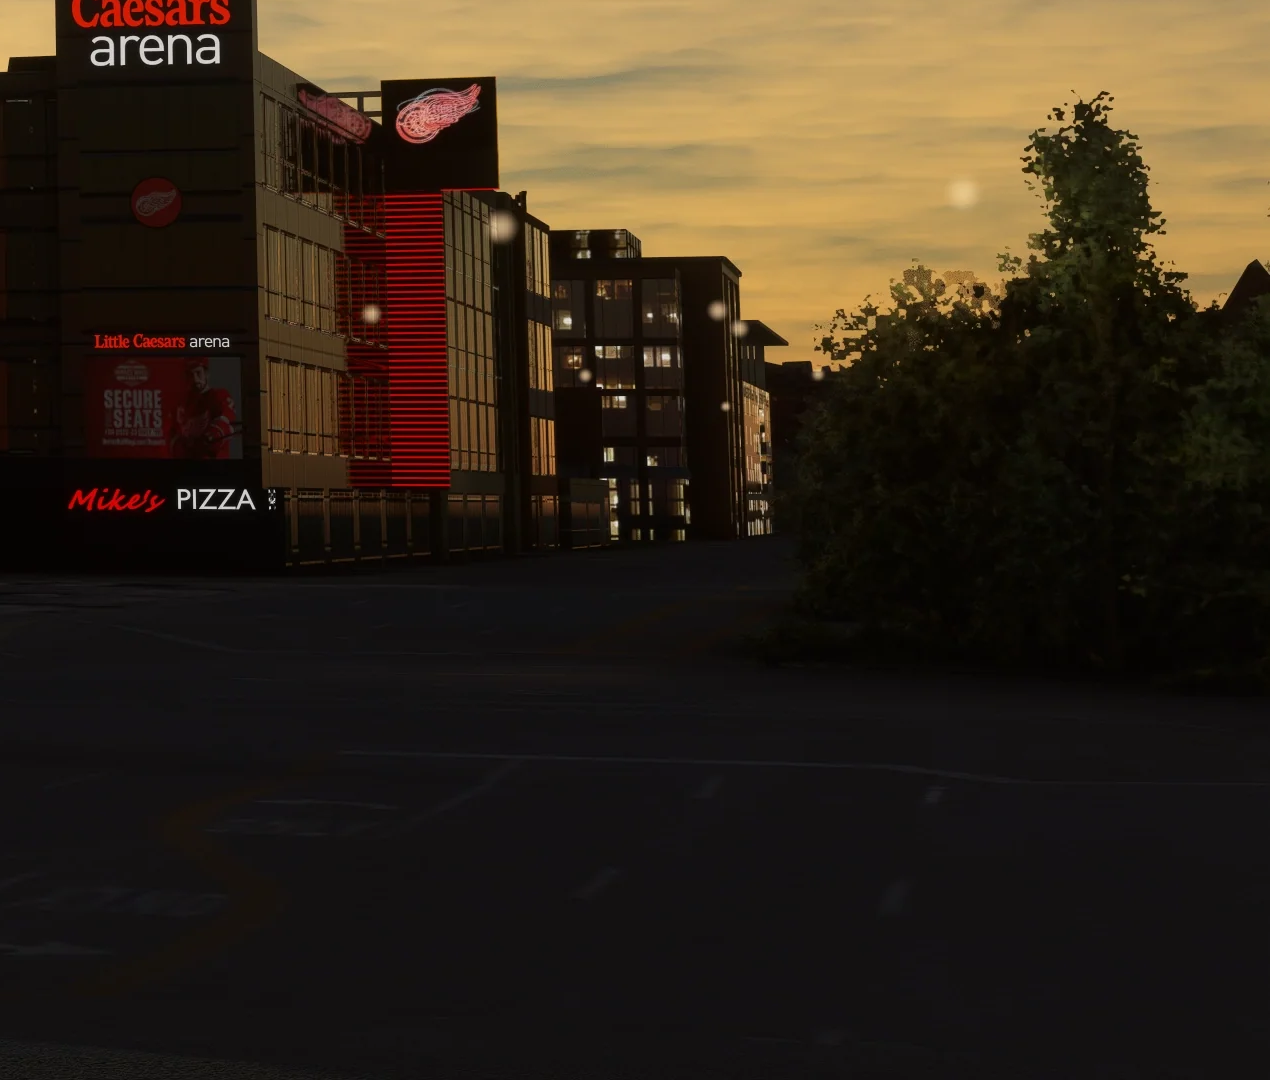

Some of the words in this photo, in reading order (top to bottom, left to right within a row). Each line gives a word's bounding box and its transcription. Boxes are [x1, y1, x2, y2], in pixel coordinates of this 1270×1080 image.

[89, 33, 221, 67] arena
[94, 334, 130, 349] Little
[132, 333, 186, 349] Caesars
[189, 335, 230, 348] arena
[103, 389, 162, 408] SECURE
[113, 409, 162, 428] SEATS
[67, 487, 166, 513] Mike's
[177, 488, 257, 510] PIZZA
